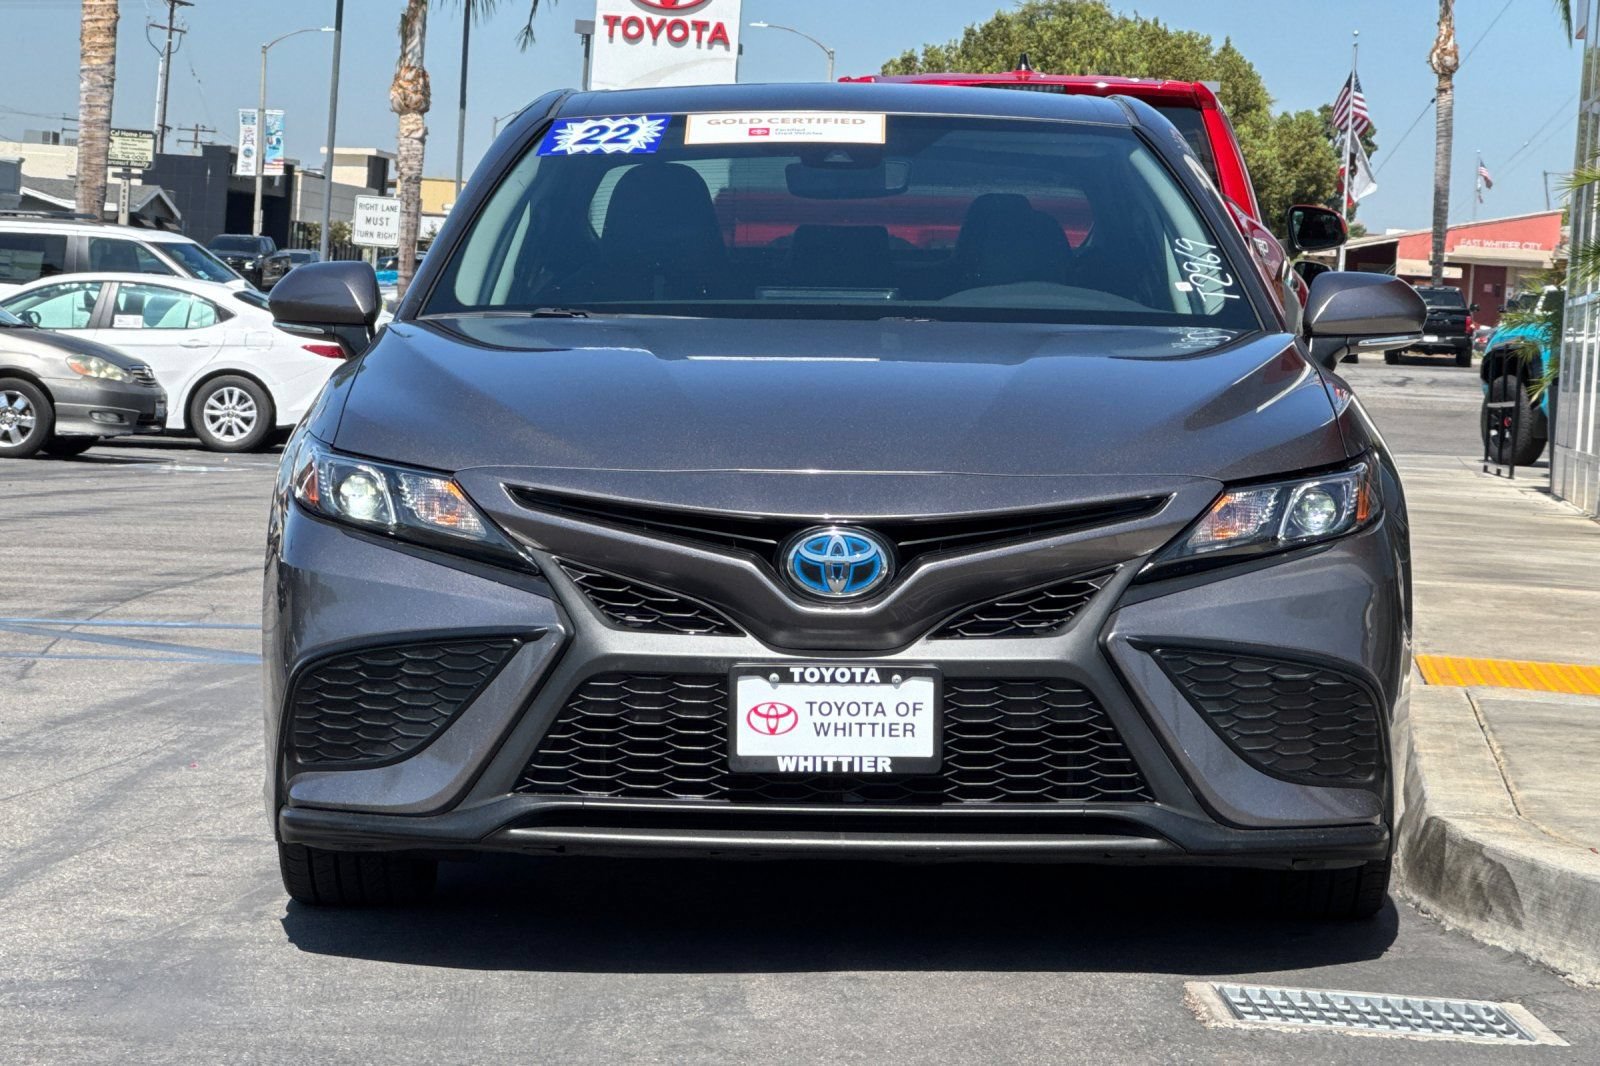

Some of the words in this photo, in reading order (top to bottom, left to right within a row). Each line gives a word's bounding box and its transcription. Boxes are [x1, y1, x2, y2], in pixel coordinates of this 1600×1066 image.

[603, 15, 730, 48] TOYOTA
[707, 117, 764, 126] GOLD
[767, 117, 866, 126] CERTIFIED
[572, 123, 641, 146] 22
[382, 204, 398, 212] LANE
[366, 216, 390, 226] MUST
[356, 230, 374, 238] TURN
[1460, 238, 1481, 247] EAST
[1521, 241, 1543, 250] CITY
[789, 667, 880, 683] TOYOTA
[805, 701, 887, 717] TOYOTA
[895, 702, 924, 717] OF
[813, 722, 916, 738] WHITTIER
[777, 756, 892, 773] WHITTIER
